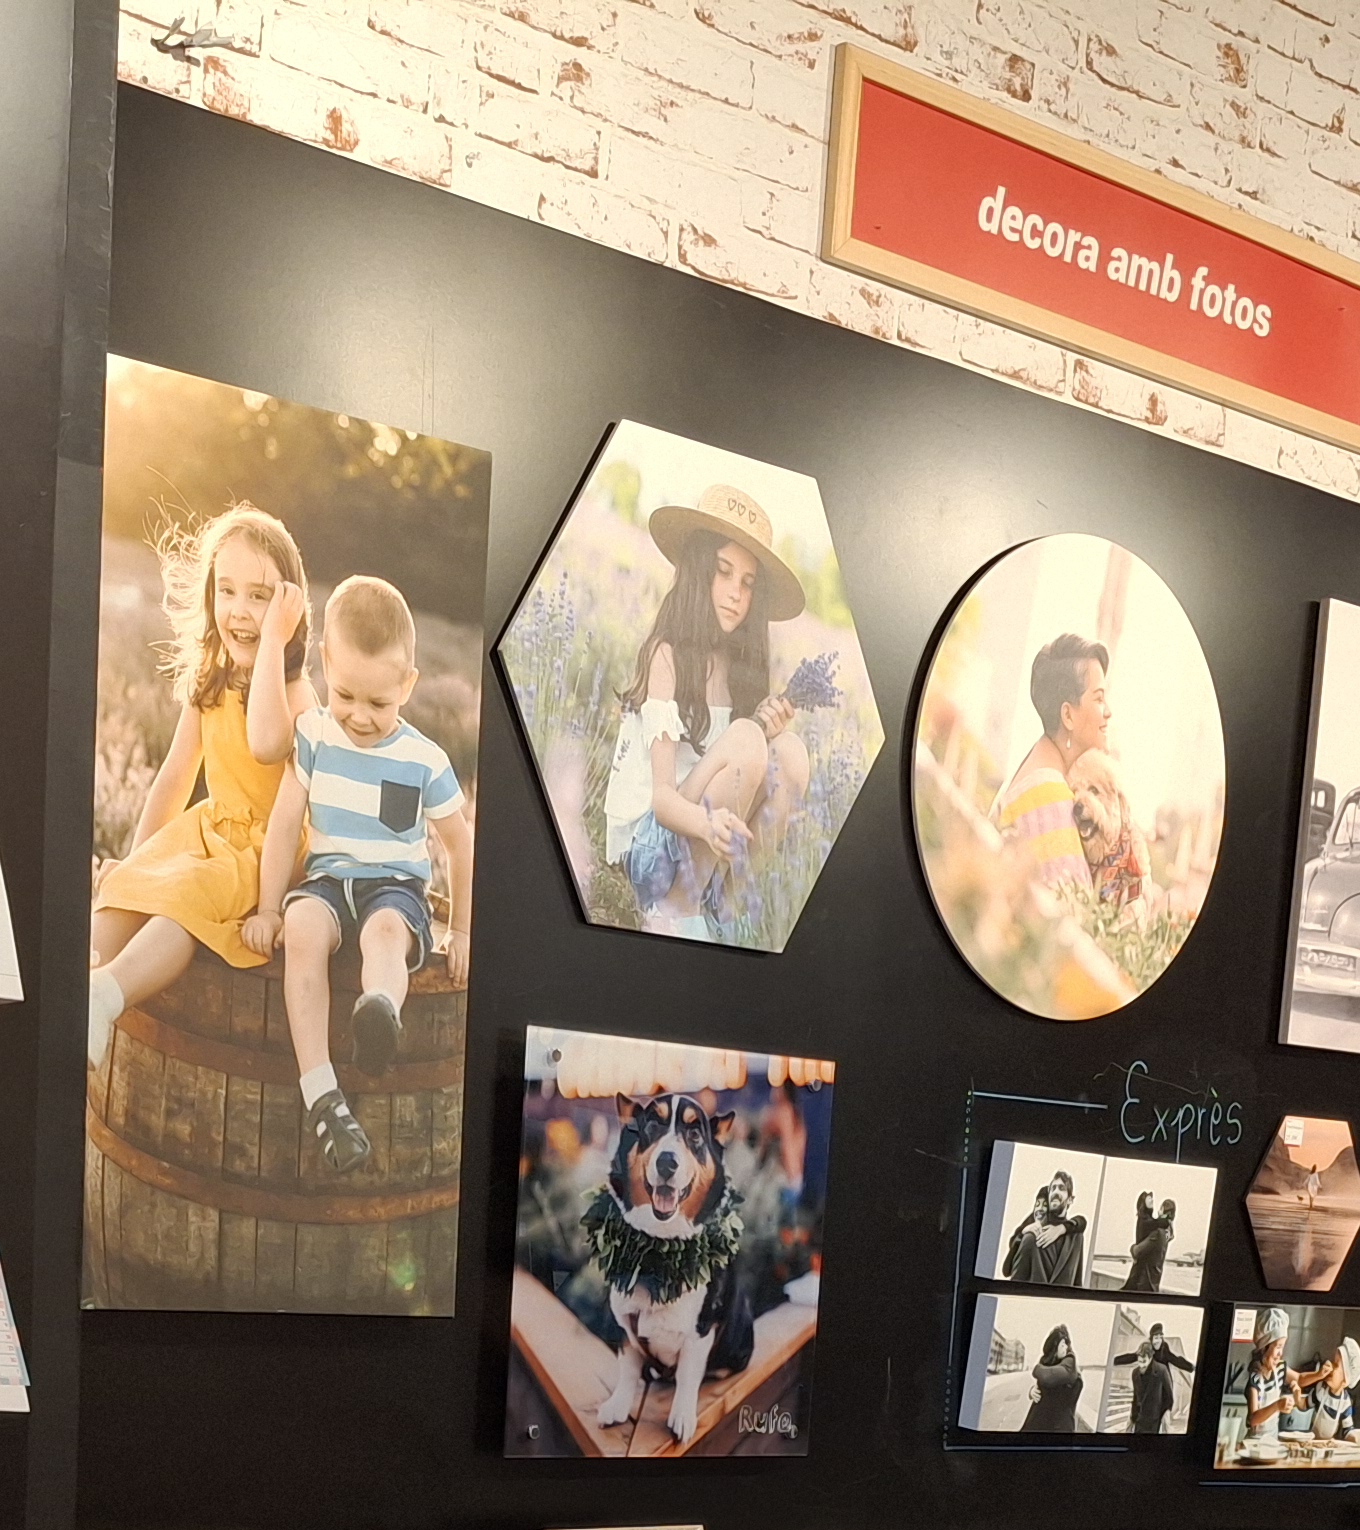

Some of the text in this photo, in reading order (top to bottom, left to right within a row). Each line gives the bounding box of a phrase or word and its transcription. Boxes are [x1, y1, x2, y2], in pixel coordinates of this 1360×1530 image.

[978, 185, 1272, 338] decora amb fotos
[1120, 1059, 1244, 1164] Exprès
